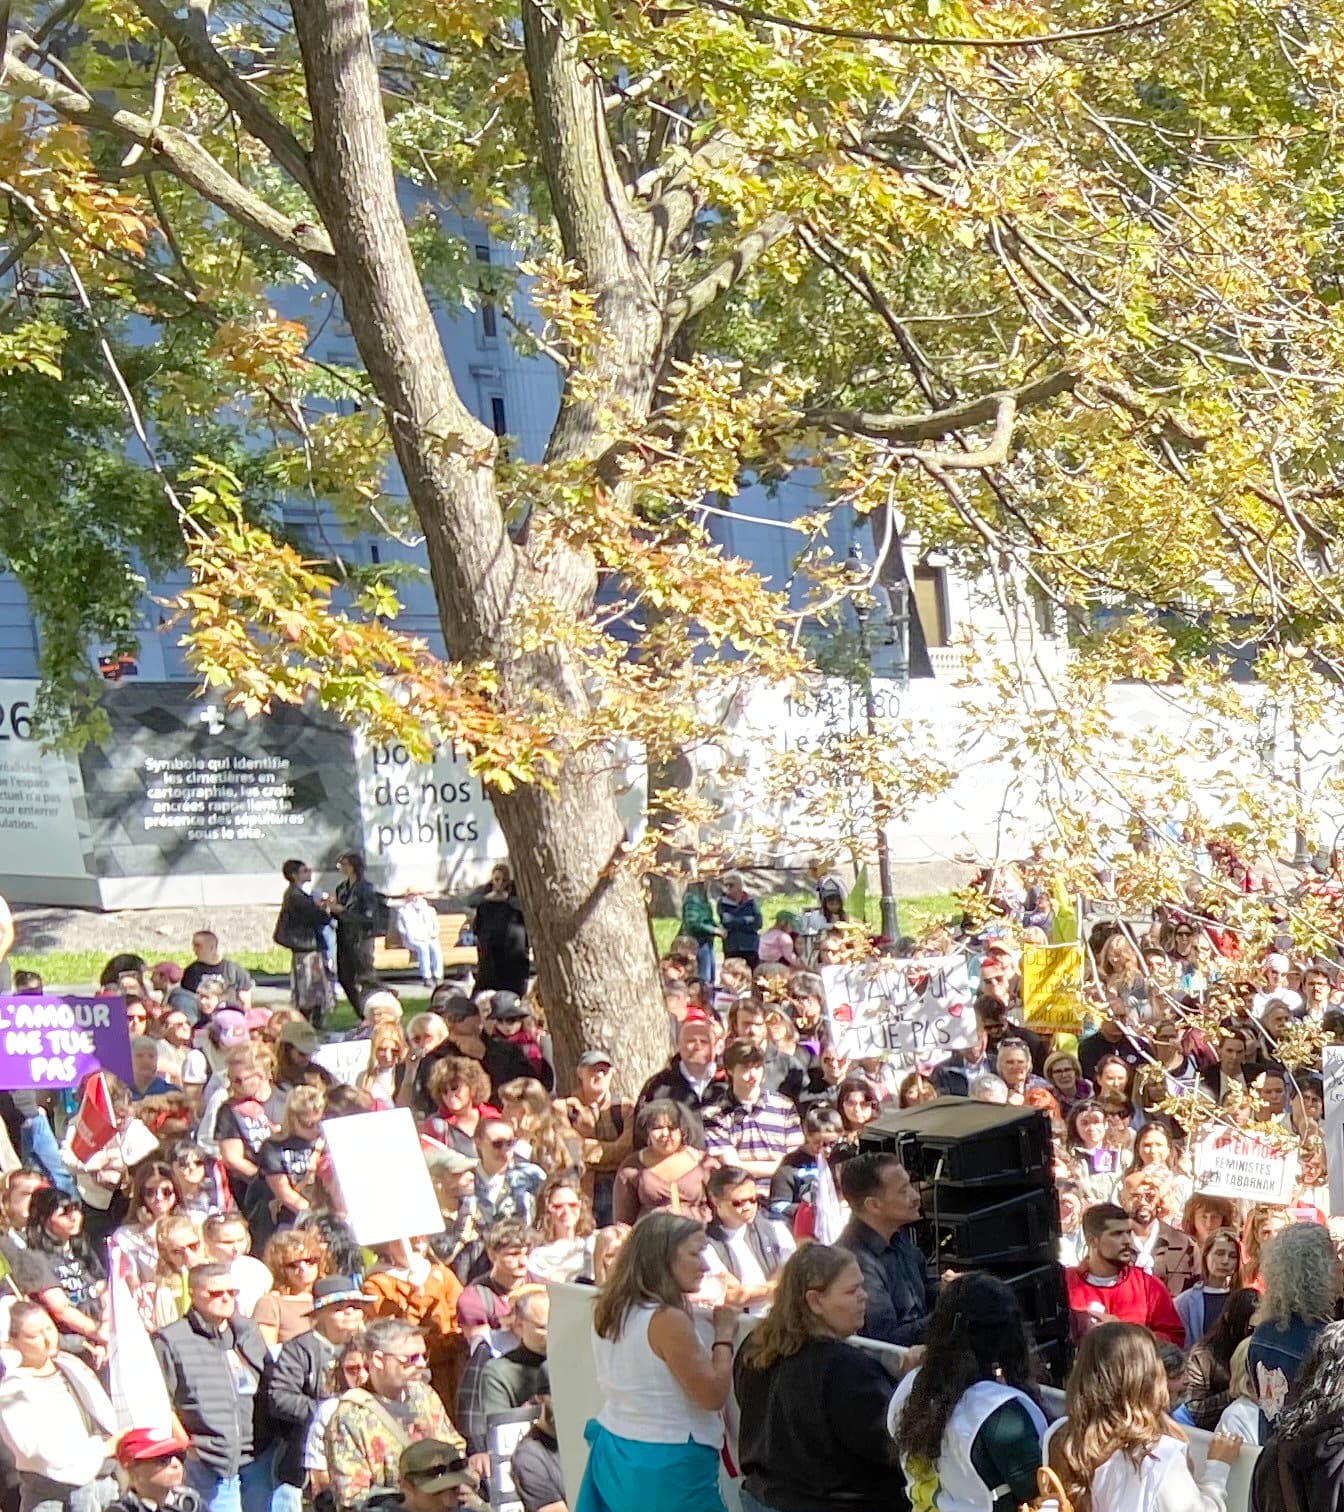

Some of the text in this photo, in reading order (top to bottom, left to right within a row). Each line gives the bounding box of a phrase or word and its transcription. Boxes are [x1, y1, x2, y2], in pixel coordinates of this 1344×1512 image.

[145, 756, 291, 773] Symbole qui identifie
[258, 773, 275, 783] en
[262, 784, 295, 798] croix
[375, 777, 409, 807] de
[422, 781, 471, 804] nos
[208, 813, 232, 825] des
[221, 826, 234, 839] le
[378, 813, 478, 855] publics
[0, 1003, 110, 1030] L'AMOUR
[6, 1030, 96, 1055] NE TUE
[848, 1018, 951, 1050] TUE PAS
[30, 1056, 77, 1083] PAS
[1225, 1173, 1276, 1191] TABARNAK
